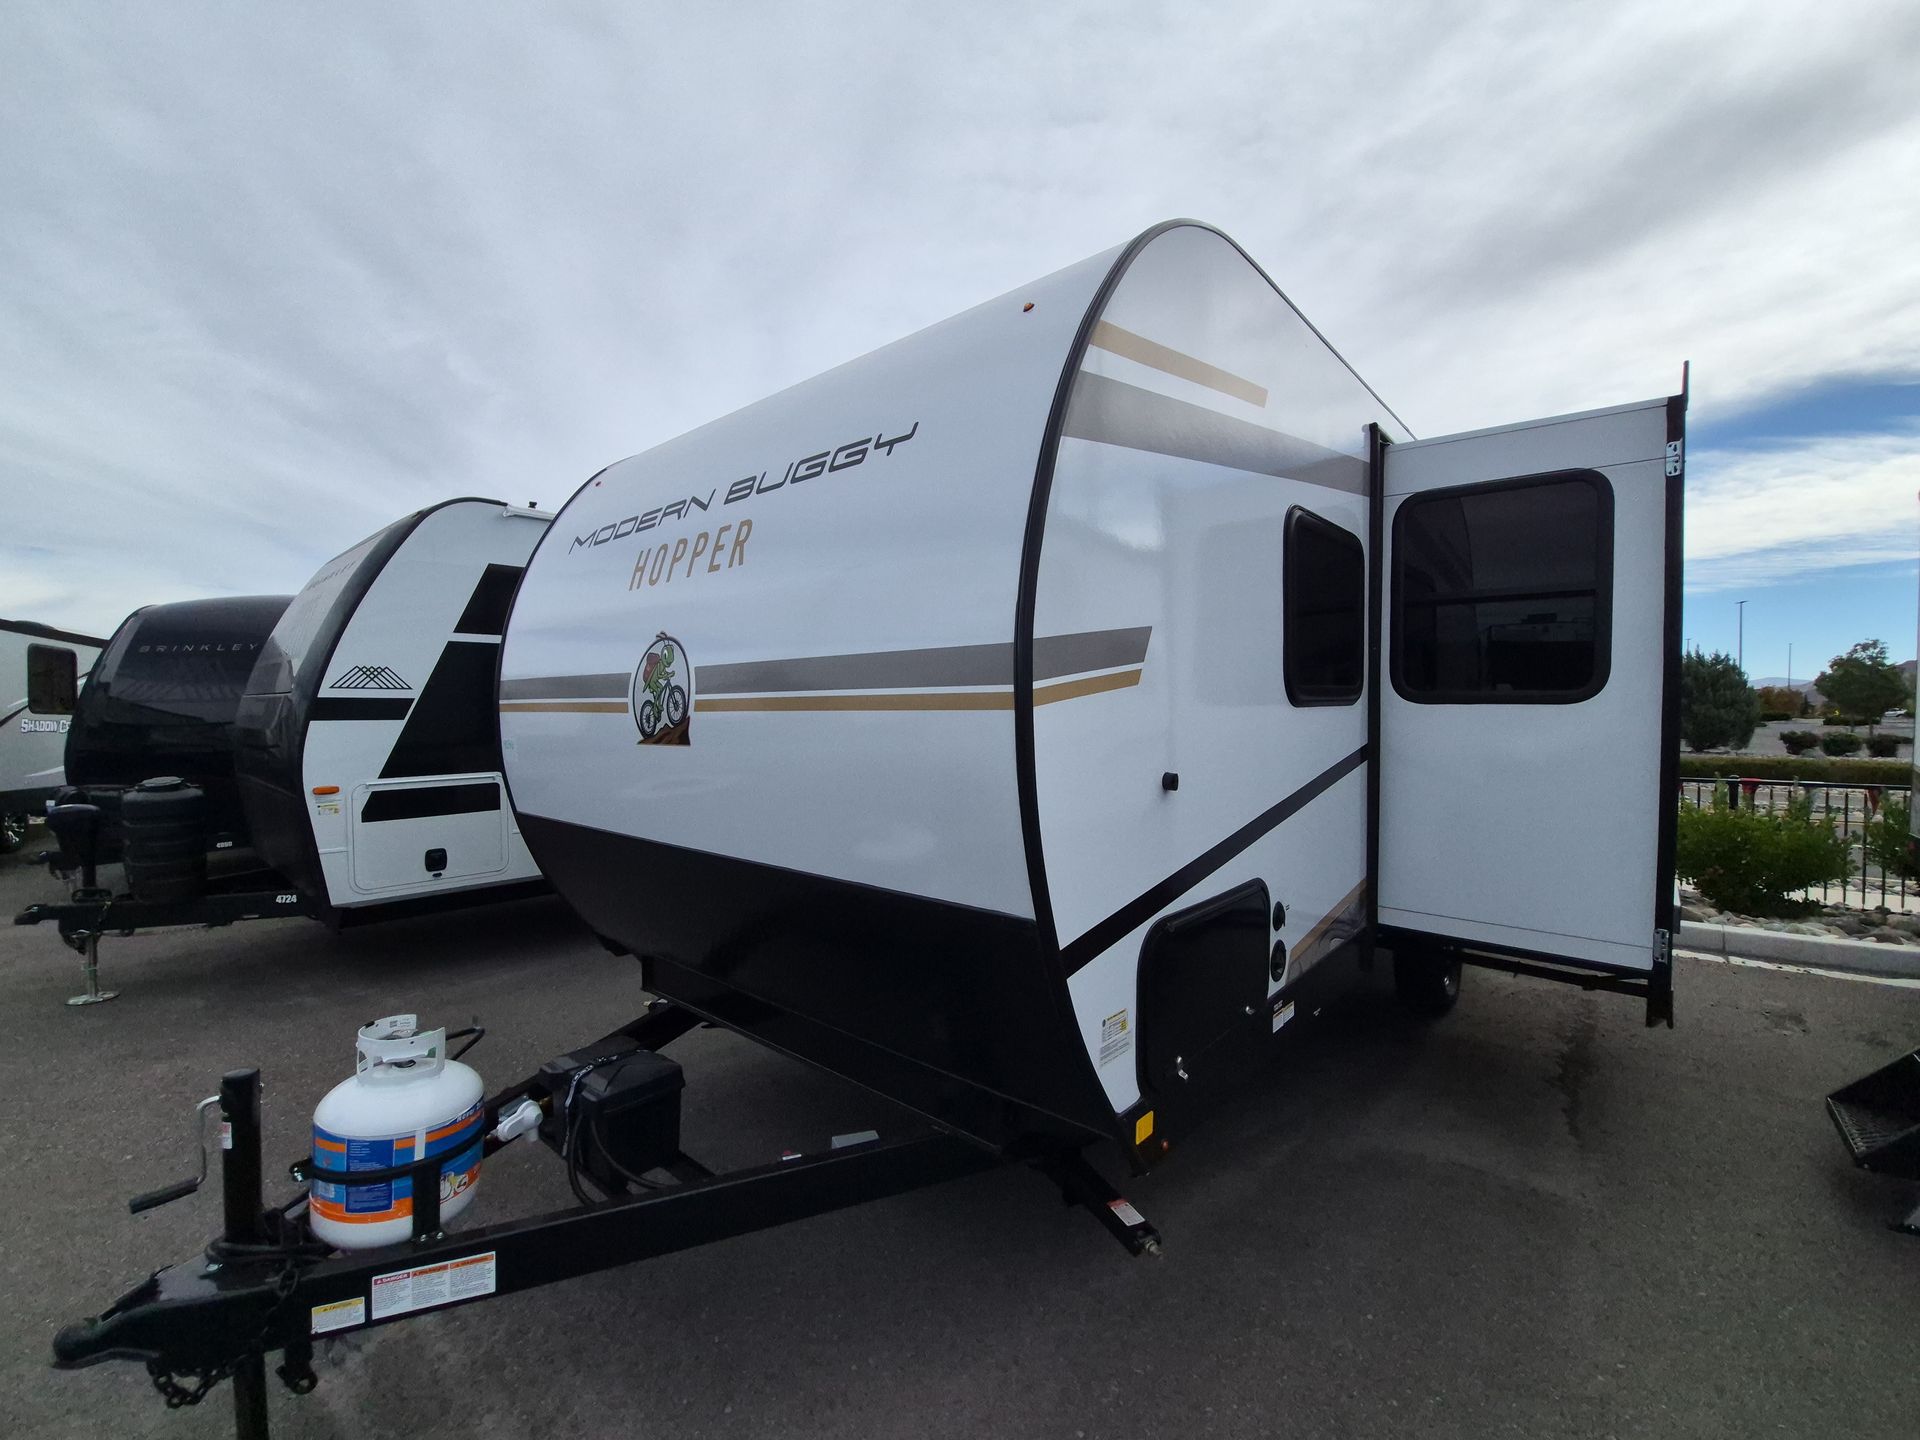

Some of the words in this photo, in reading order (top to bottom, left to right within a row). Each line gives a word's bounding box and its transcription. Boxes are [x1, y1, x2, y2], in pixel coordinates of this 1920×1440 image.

[568, 488, 717, 555] MODERN
[723, 421, 920, 506] BUGGY
[628, 518, 754, 592] HOPPER
[139, 643, 259, 653] BRINKLEY
[21, 718, 58, 733] SHADOW
[275, 894, 298, 904] 4724
